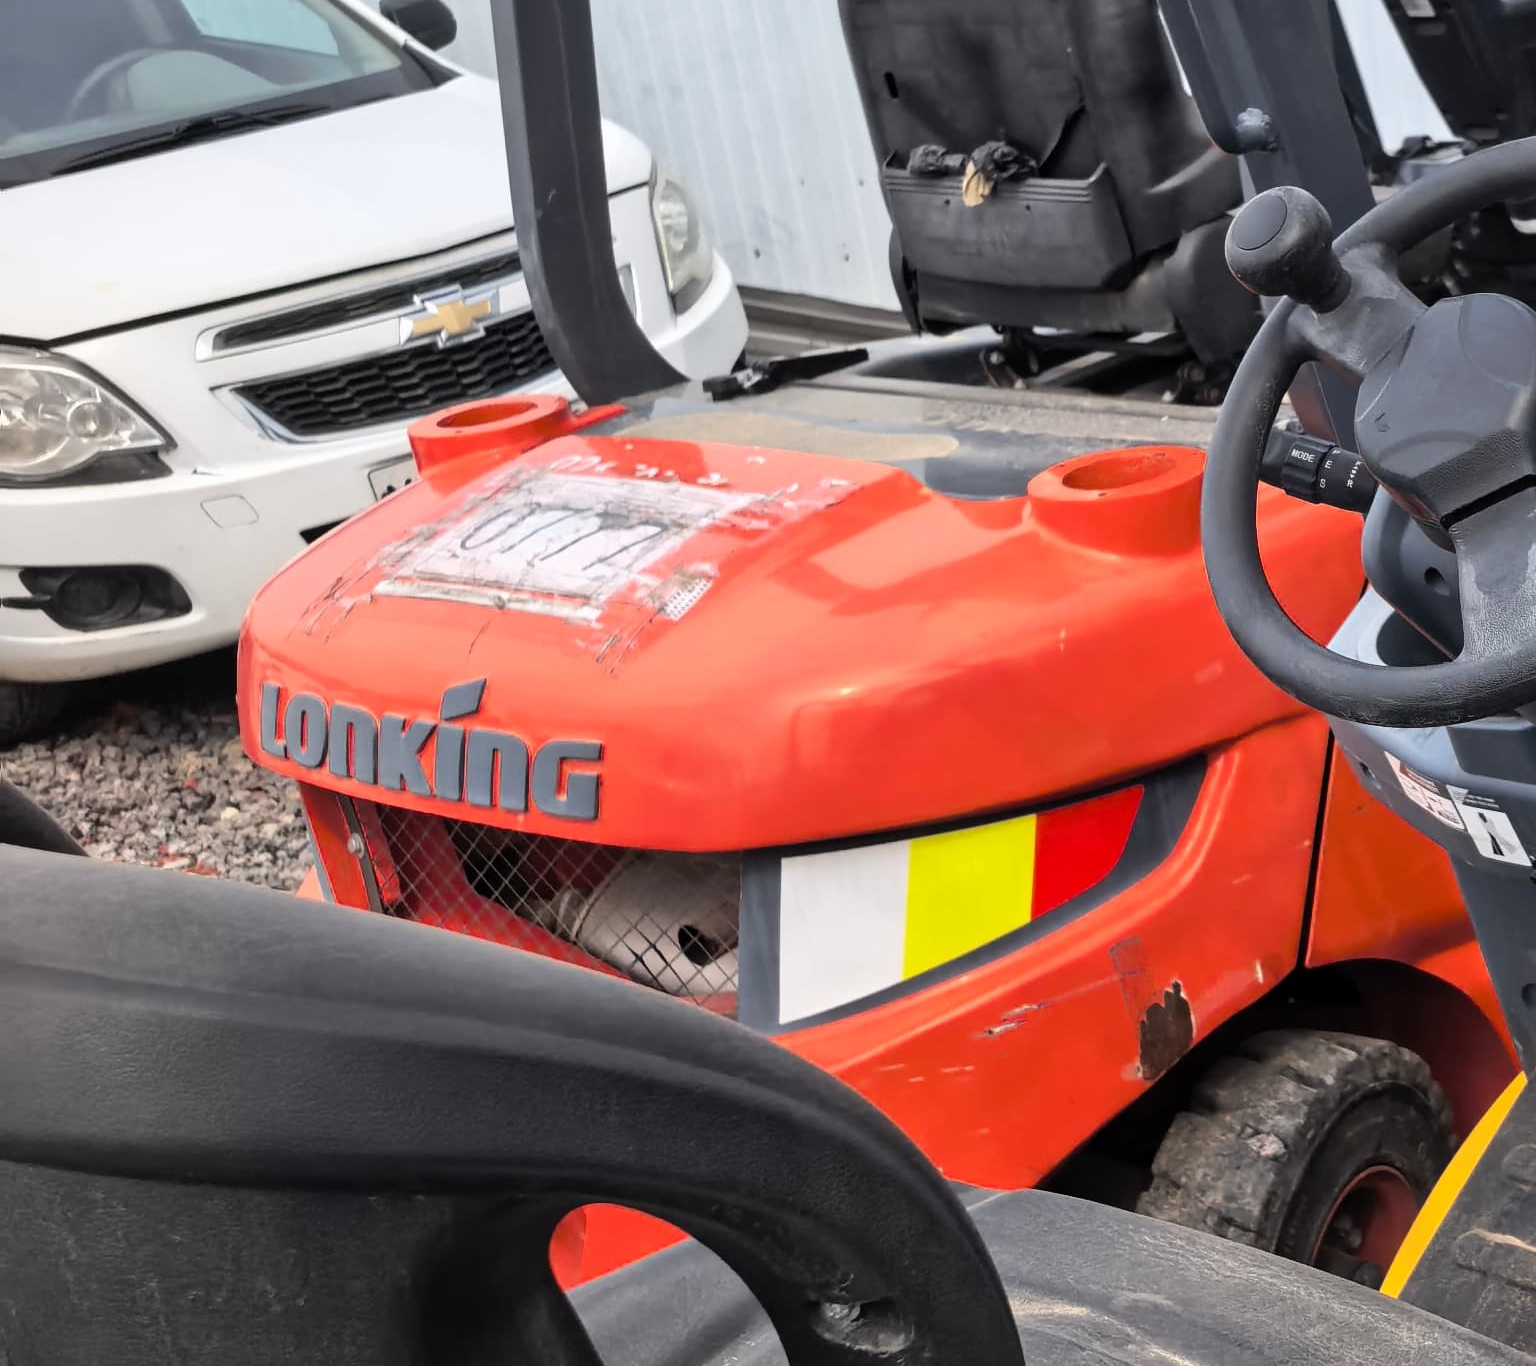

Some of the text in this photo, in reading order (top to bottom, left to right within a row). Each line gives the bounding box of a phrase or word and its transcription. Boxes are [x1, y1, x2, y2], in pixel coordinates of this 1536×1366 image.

[1290, 448, 1316, 463] MODE
[1325, 460, 1333, 469] E
[1319, 478, 1326, 488] S
[1347, 479, 1354, 488] R
